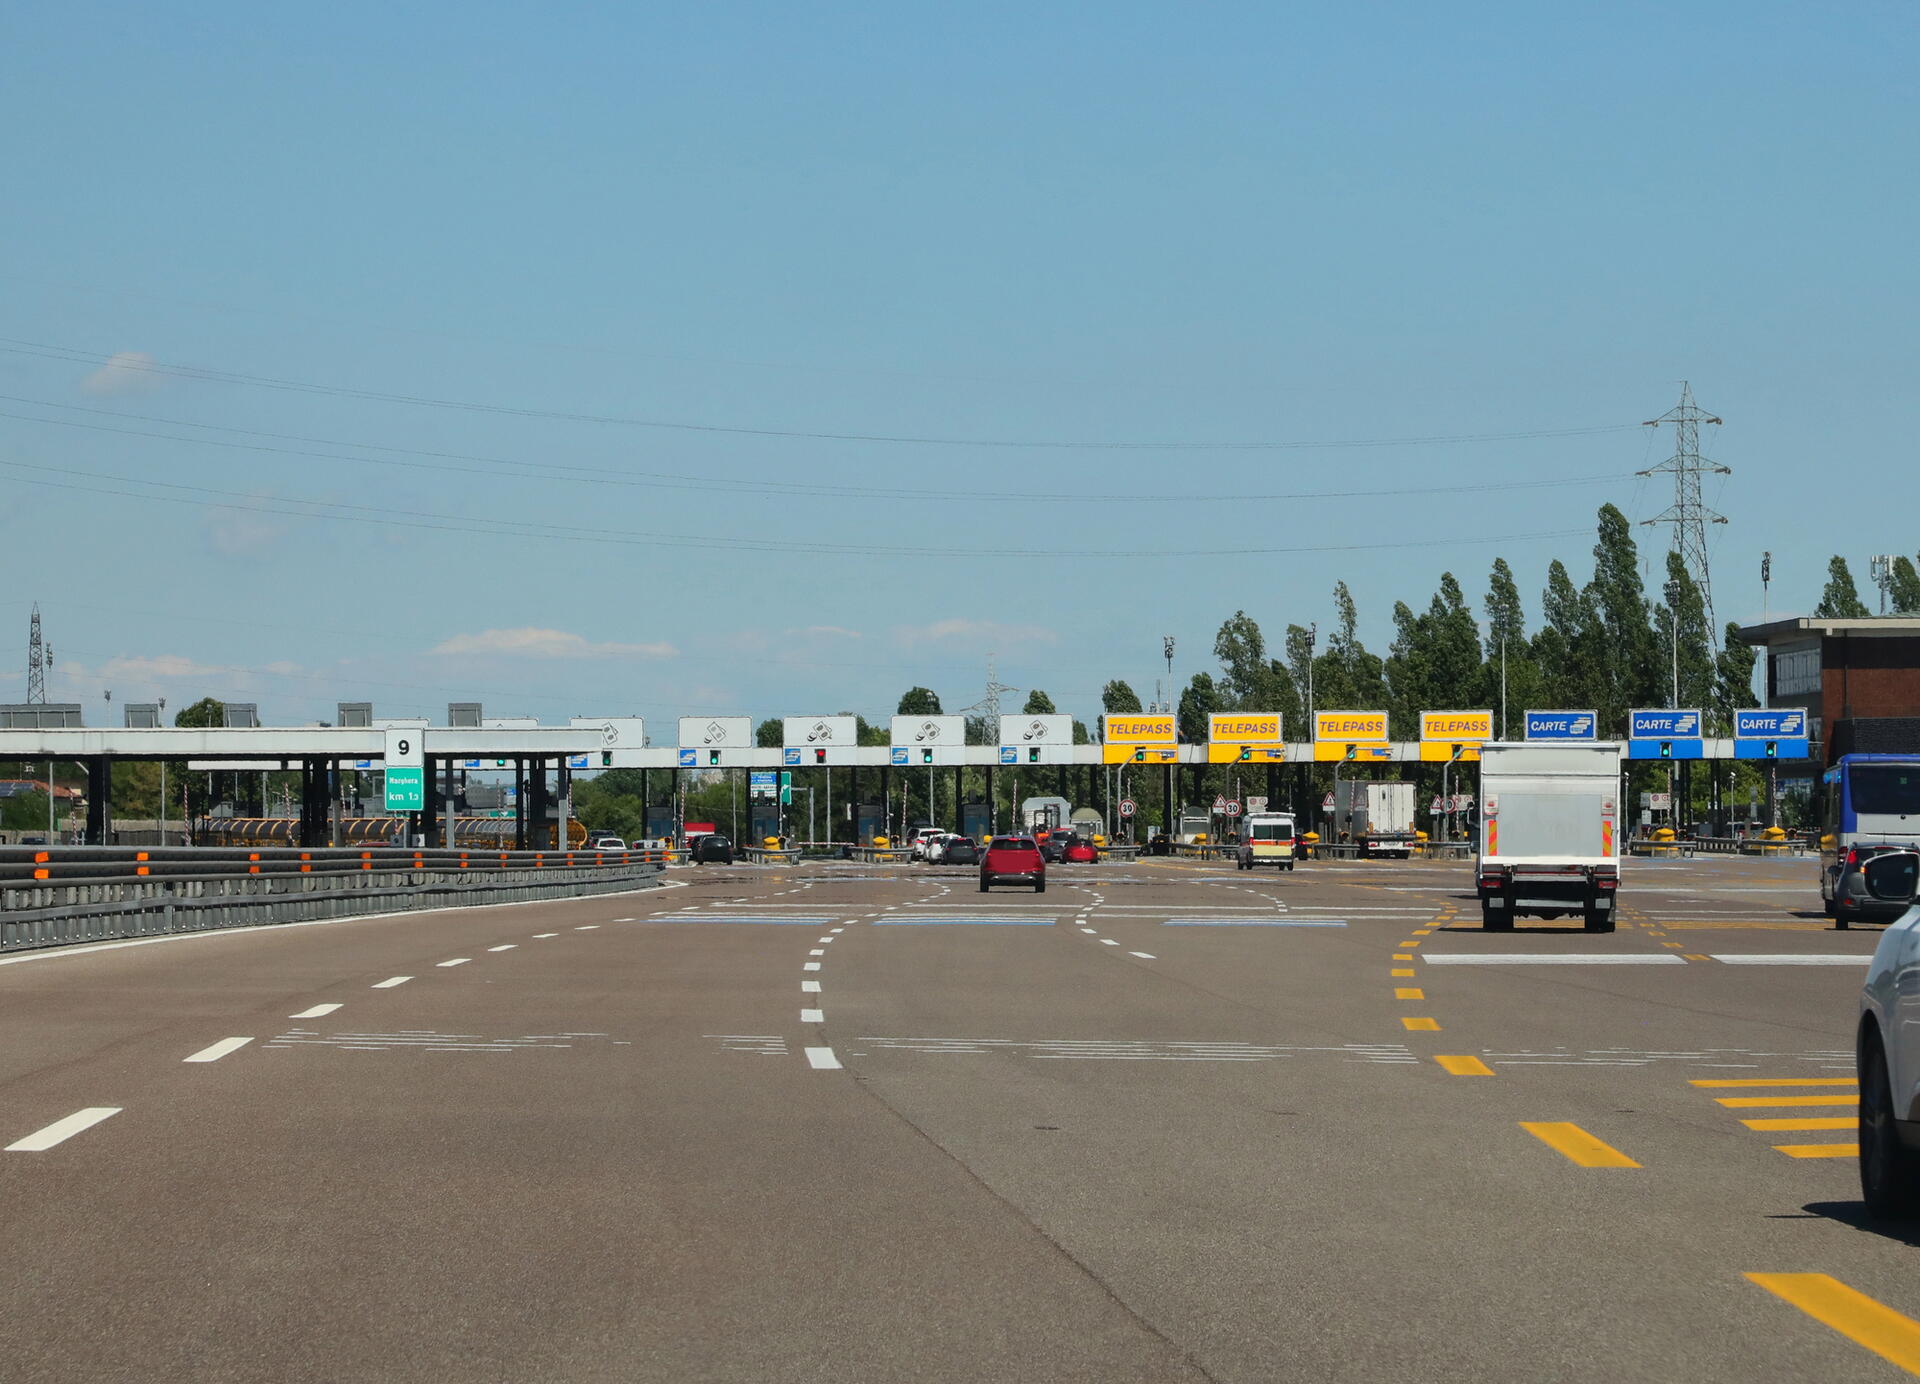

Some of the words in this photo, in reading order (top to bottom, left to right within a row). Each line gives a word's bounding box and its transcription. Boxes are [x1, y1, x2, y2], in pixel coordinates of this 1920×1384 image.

[1109, 723, 1172, 735] TELEPASS
[1213, 722, 1277, 734] TELEPASS
[1320, 720, 1384, 732] TELEPASS
[1425, 720, 1488, 732] TELEPASS
[1530, 720, 1567, 731] CARTE
[1636, 719, 1672, 730] CARTE
[1740, 718, 1777, 730] CARTE
[398, 740, 410, 755] 9
[389, 792, 404, 800] km
[1122, 803, 1133, 813] 30
[1227, 804, 1238, 813] 30
